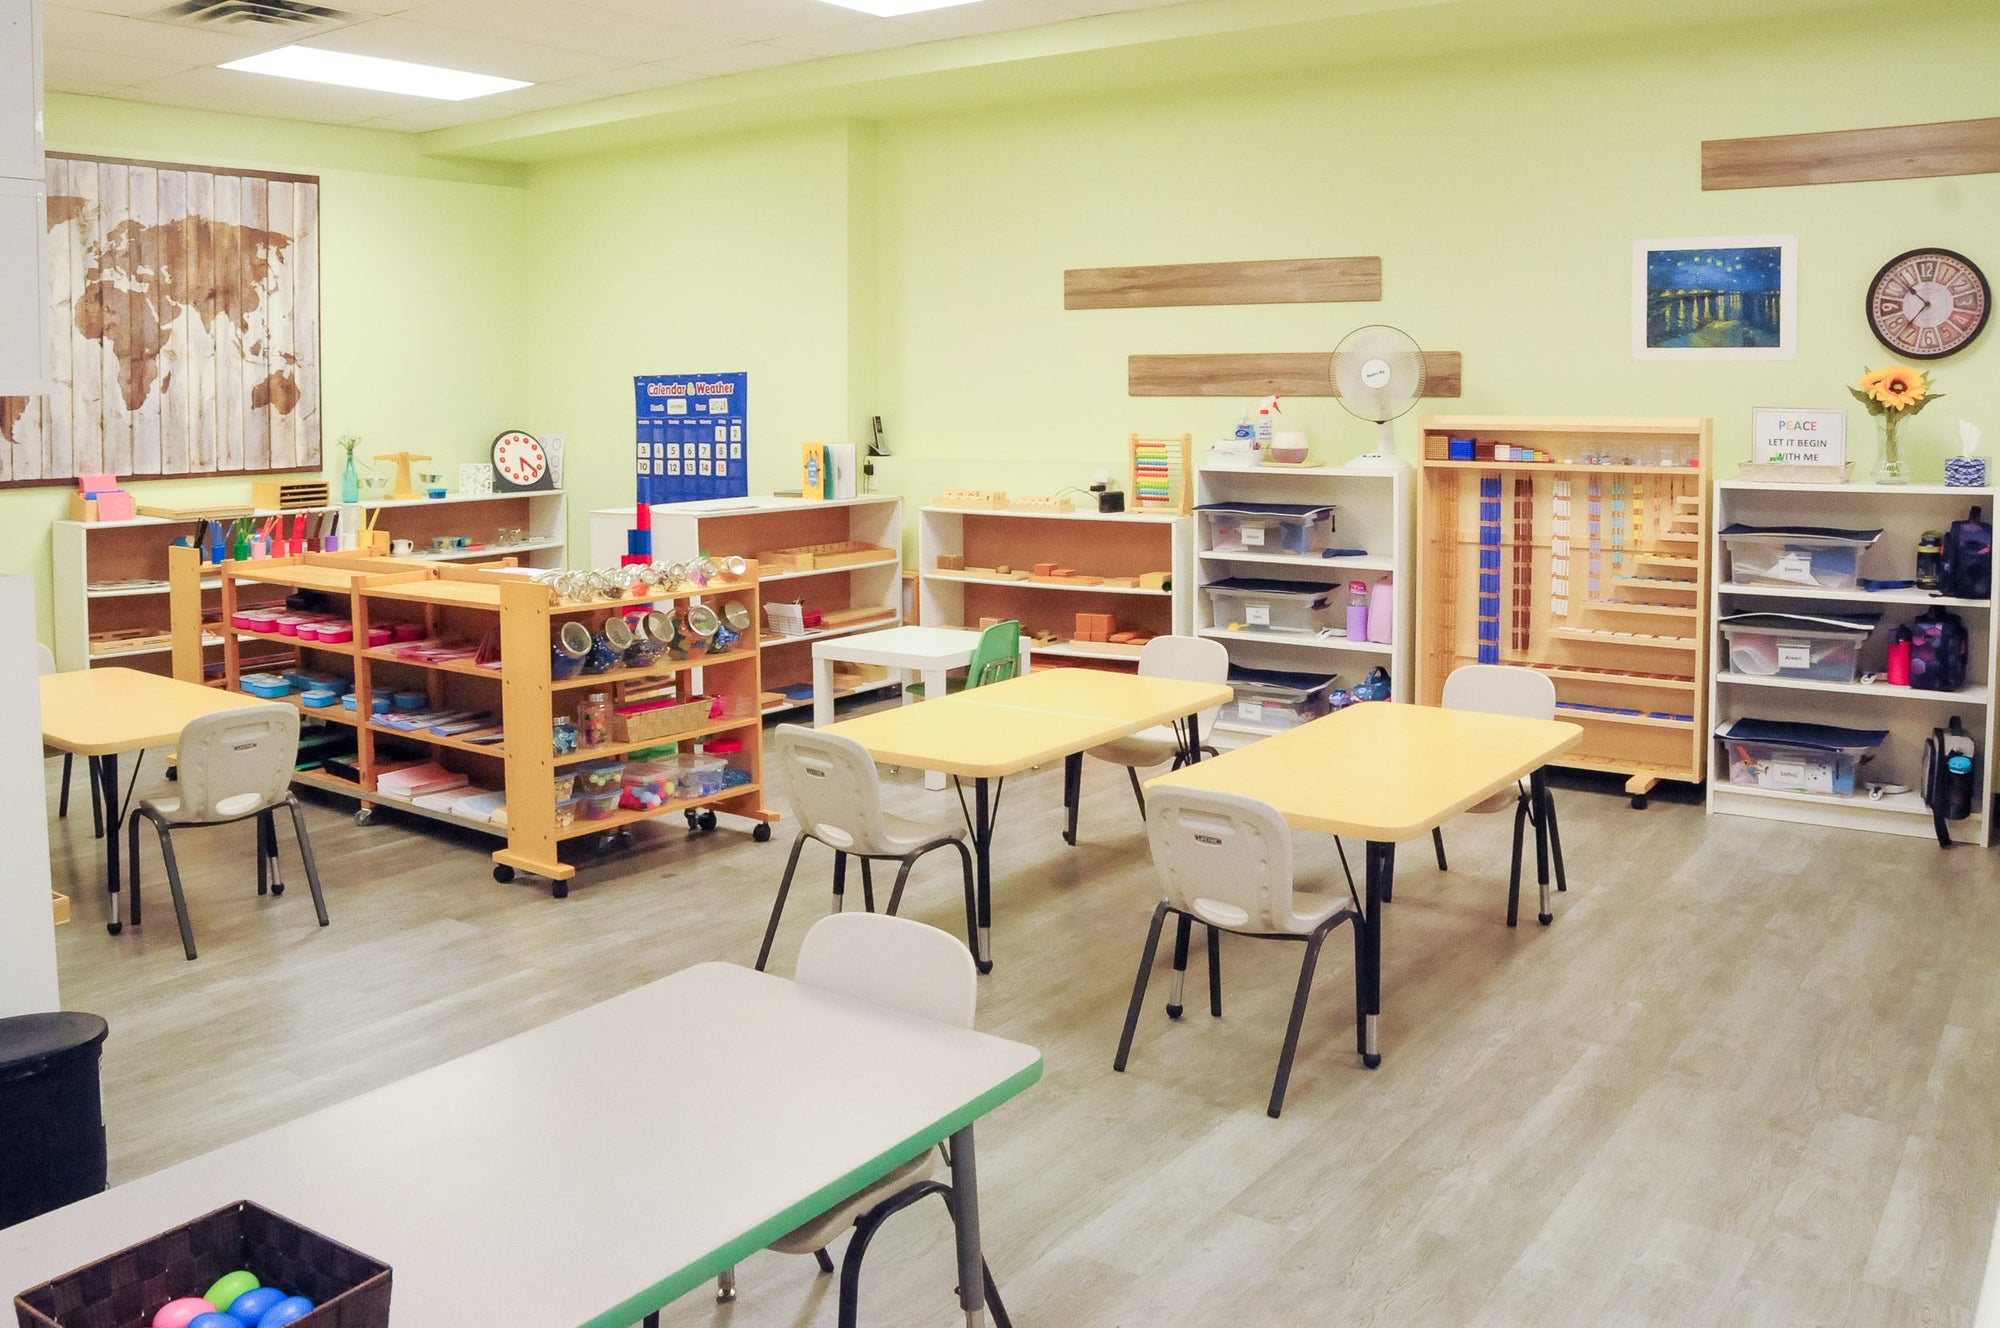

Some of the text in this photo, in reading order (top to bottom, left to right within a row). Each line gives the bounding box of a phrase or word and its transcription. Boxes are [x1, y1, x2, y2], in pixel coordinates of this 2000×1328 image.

[648, 382, 734, 396] Calendar & Weather
[1778, 420, 1817, 431] PEACE
[1768, 438, 1784, 446] LET
[1798, 440, 1827, 448] BEGIN
[1778, 452, 1818, 462] WITH ME
[639, 462, 725, 472] 10 11 12 13 14 15
